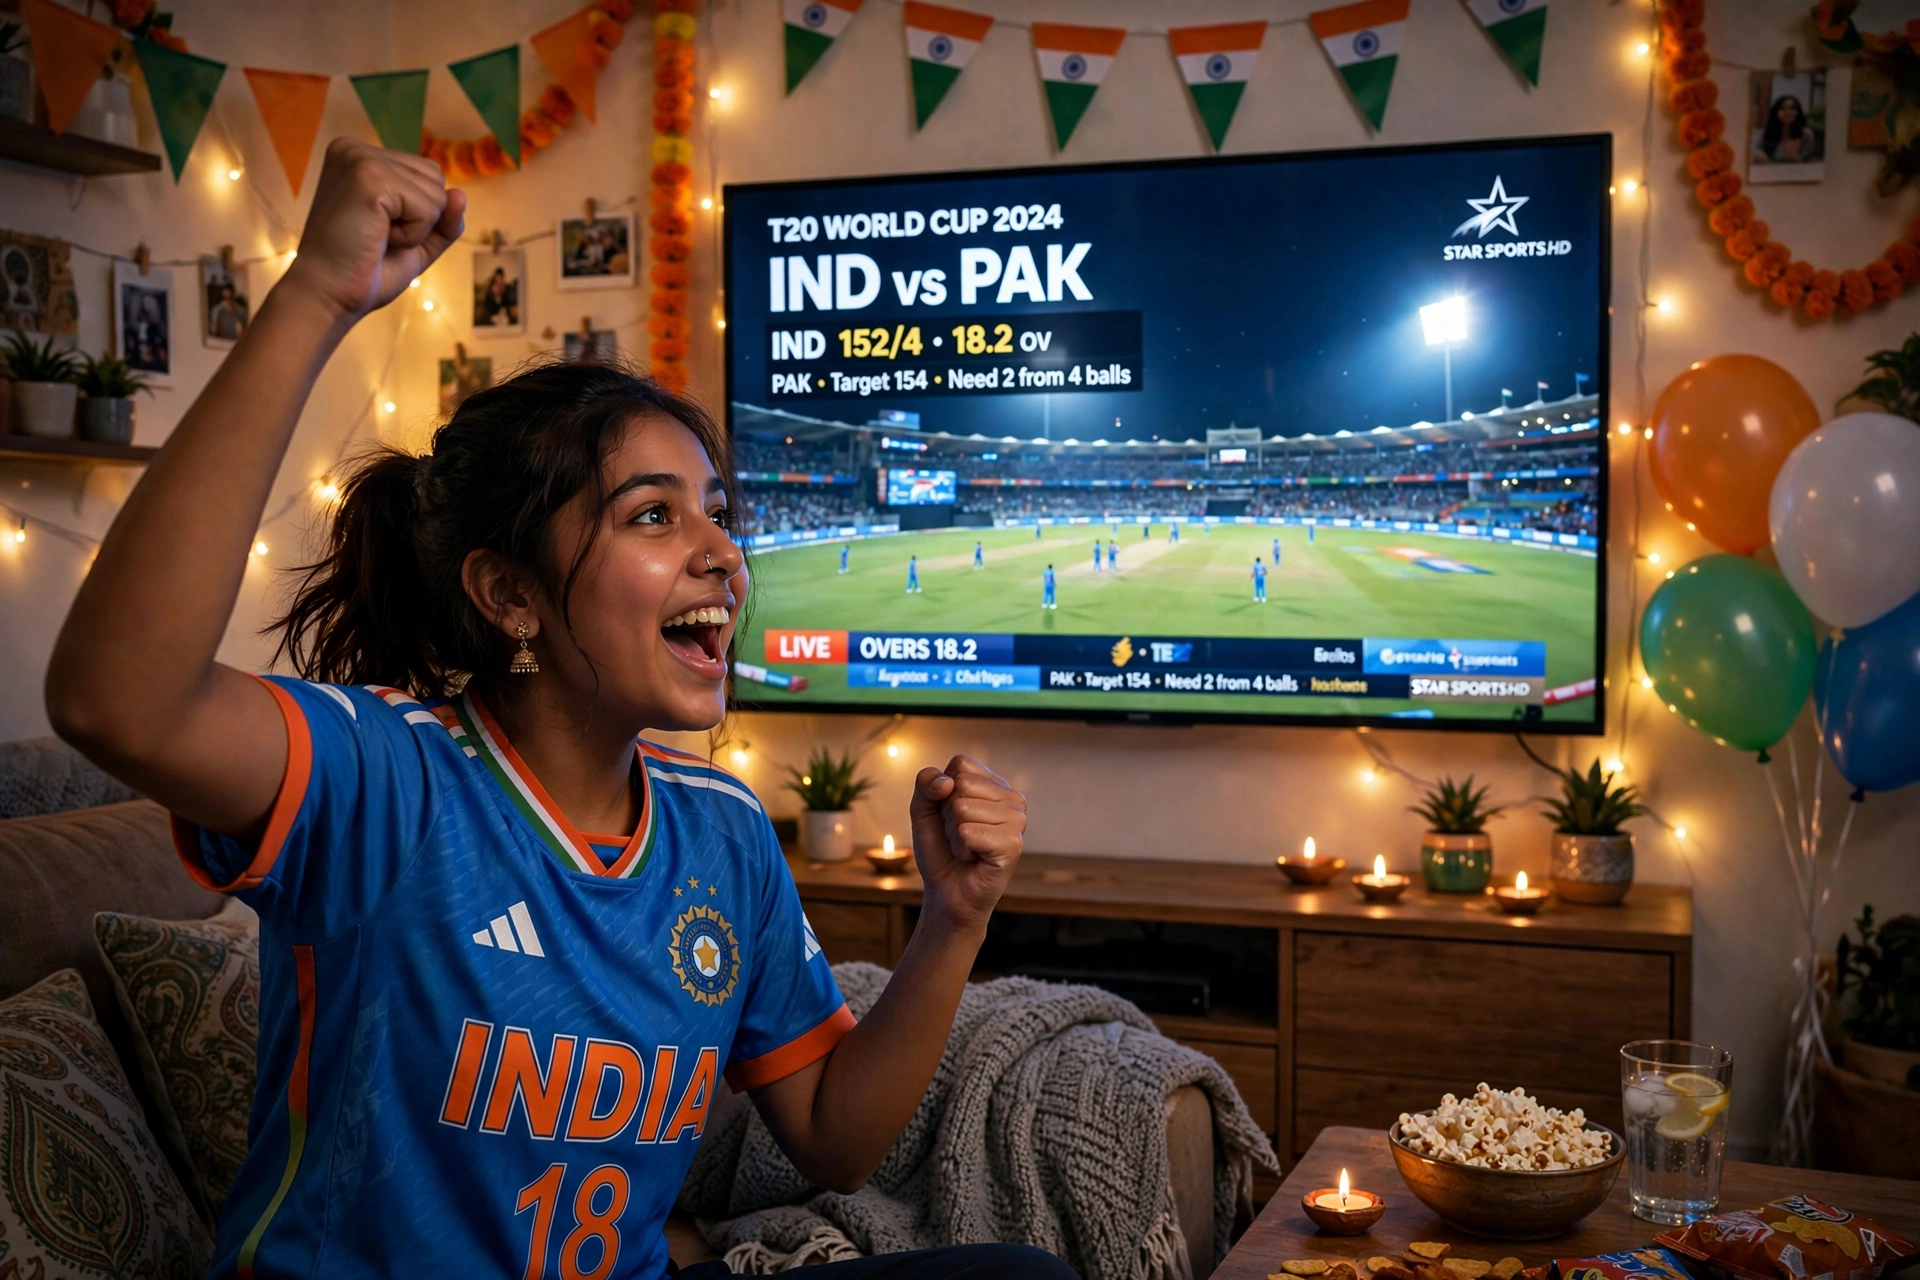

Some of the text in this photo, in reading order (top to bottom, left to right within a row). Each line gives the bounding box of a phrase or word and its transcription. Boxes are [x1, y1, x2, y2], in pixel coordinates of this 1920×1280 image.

[767, 204, 1064, 243] T20 WORLD CUP 2024
[1443, 244, 1483, 260] STAR
[770, 253, 881, 312] IND
[960, 242, 1094, 305] PAK
[772, 330, 826, 360] IND
[838, 324, 924, 360] 152/4
[952, 323, 1014, 355] 18.2
[772, 364, 1131, 396] PAK Target 154 Need 2 from 4 balls
[779, 636, 831, 659] LIVE
[860, 637, 977, 661] OVERS 18.2
[1050, 671, 1075, 686] PAK
[1084, 672, 1124, 691] Target
[1126, 672, 1151, 688] 154
[1165, 673, 1202, 690] Need
[1203, 674, 1214, 690] 2
[1216, 674, 1250, 690] from
[1252, 675, 1264, 691] 4
[1265, 674, 1299, 692] balls
[1411, 679, 1449, 695] STAR
[438, 1018, 719, 1144] INDIA
[514, 1162, 630, 1280] 18
